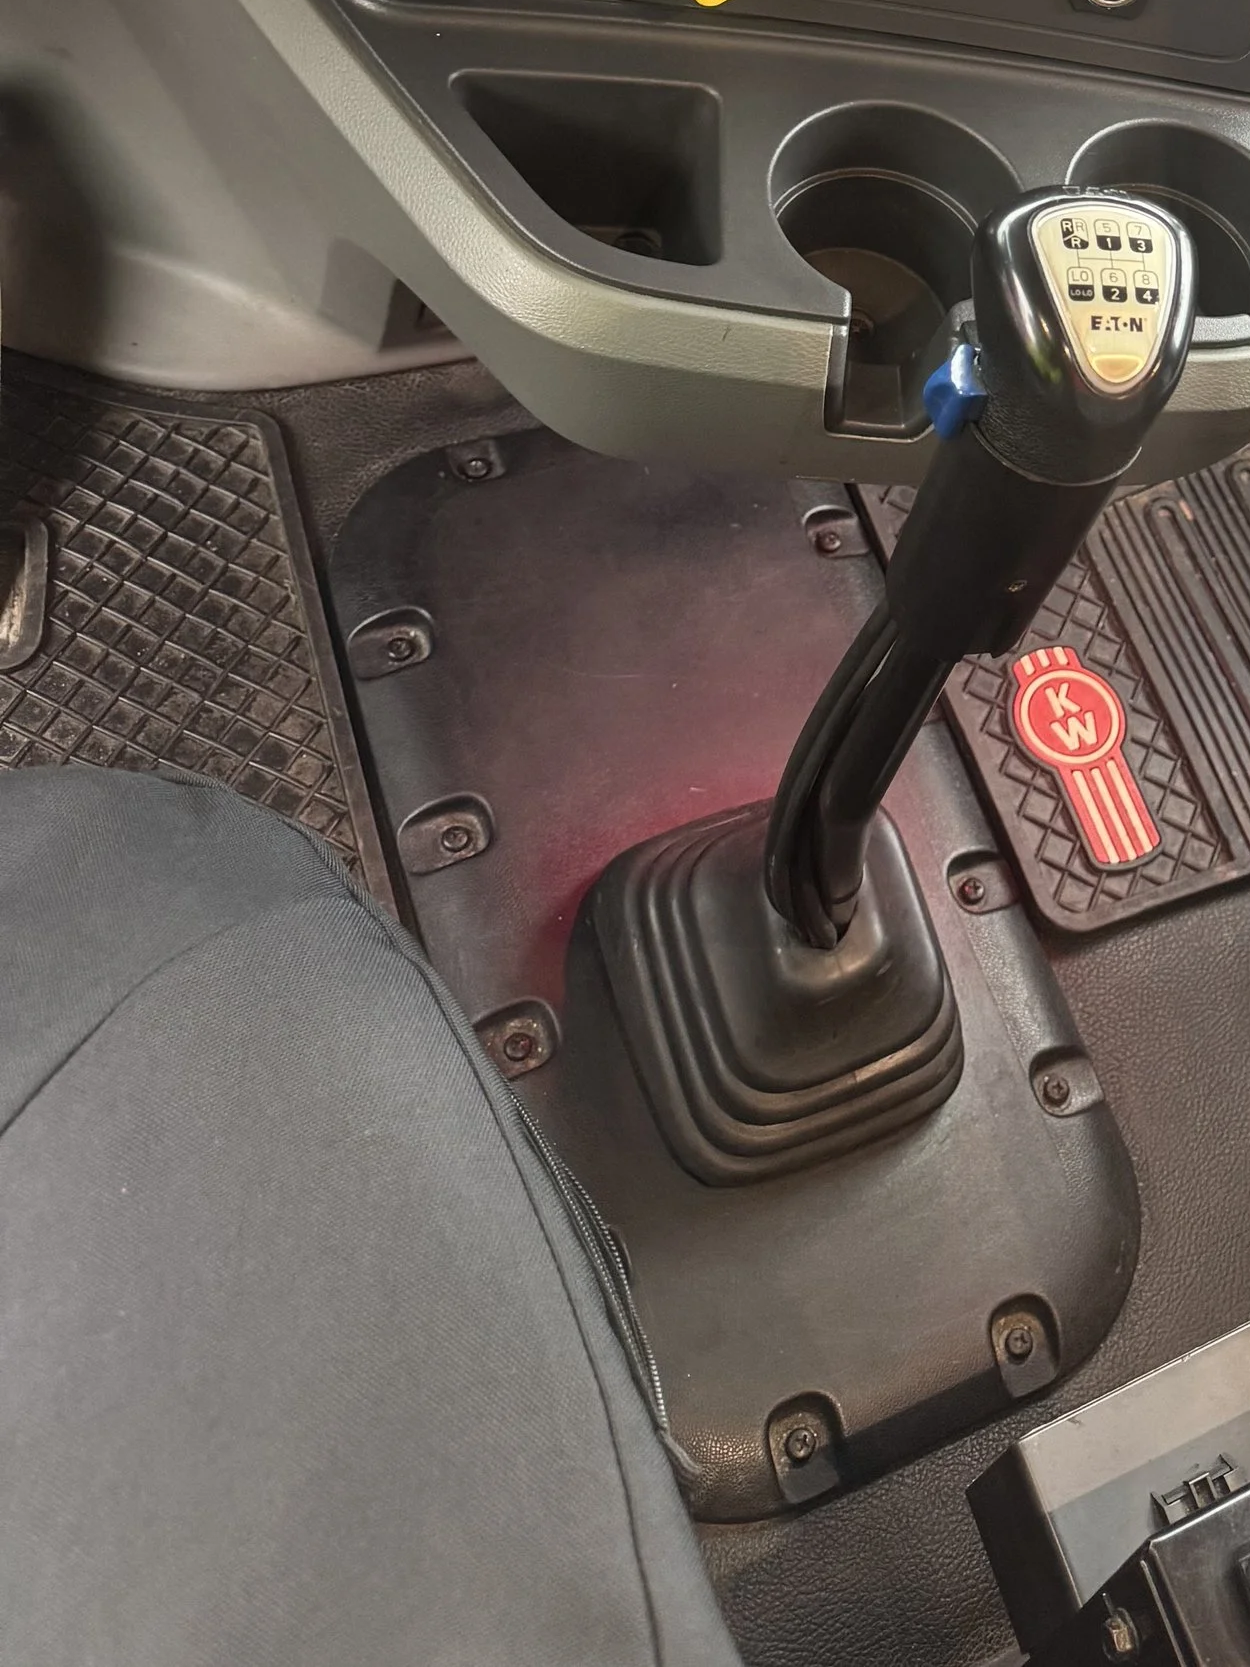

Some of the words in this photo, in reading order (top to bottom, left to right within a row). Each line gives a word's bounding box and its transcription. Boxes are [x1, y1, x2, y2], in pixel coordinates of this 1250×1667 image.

[1062, 221, 1073, 232] R
[1075, 221, 1085, 232] R
[1102, 223, 1112, 233] 5
[1134, 225, 1142, 235] 7
[1071, 238, 1081, 248] R
[1106, 238, 1112, 249] 1
[1137, 240, 1146, 251] 3
[1071, 270, 1089, 282] LO
[1109, 272, 1118, 282] 6
[1142, 274, 1150, 285] 8
[1111, 288, 1120, 300] 2
[1142, 290, 1152, 302] 4
[1045, 682, 1082, 718] K
[1050, 711, 1098, 751] W
